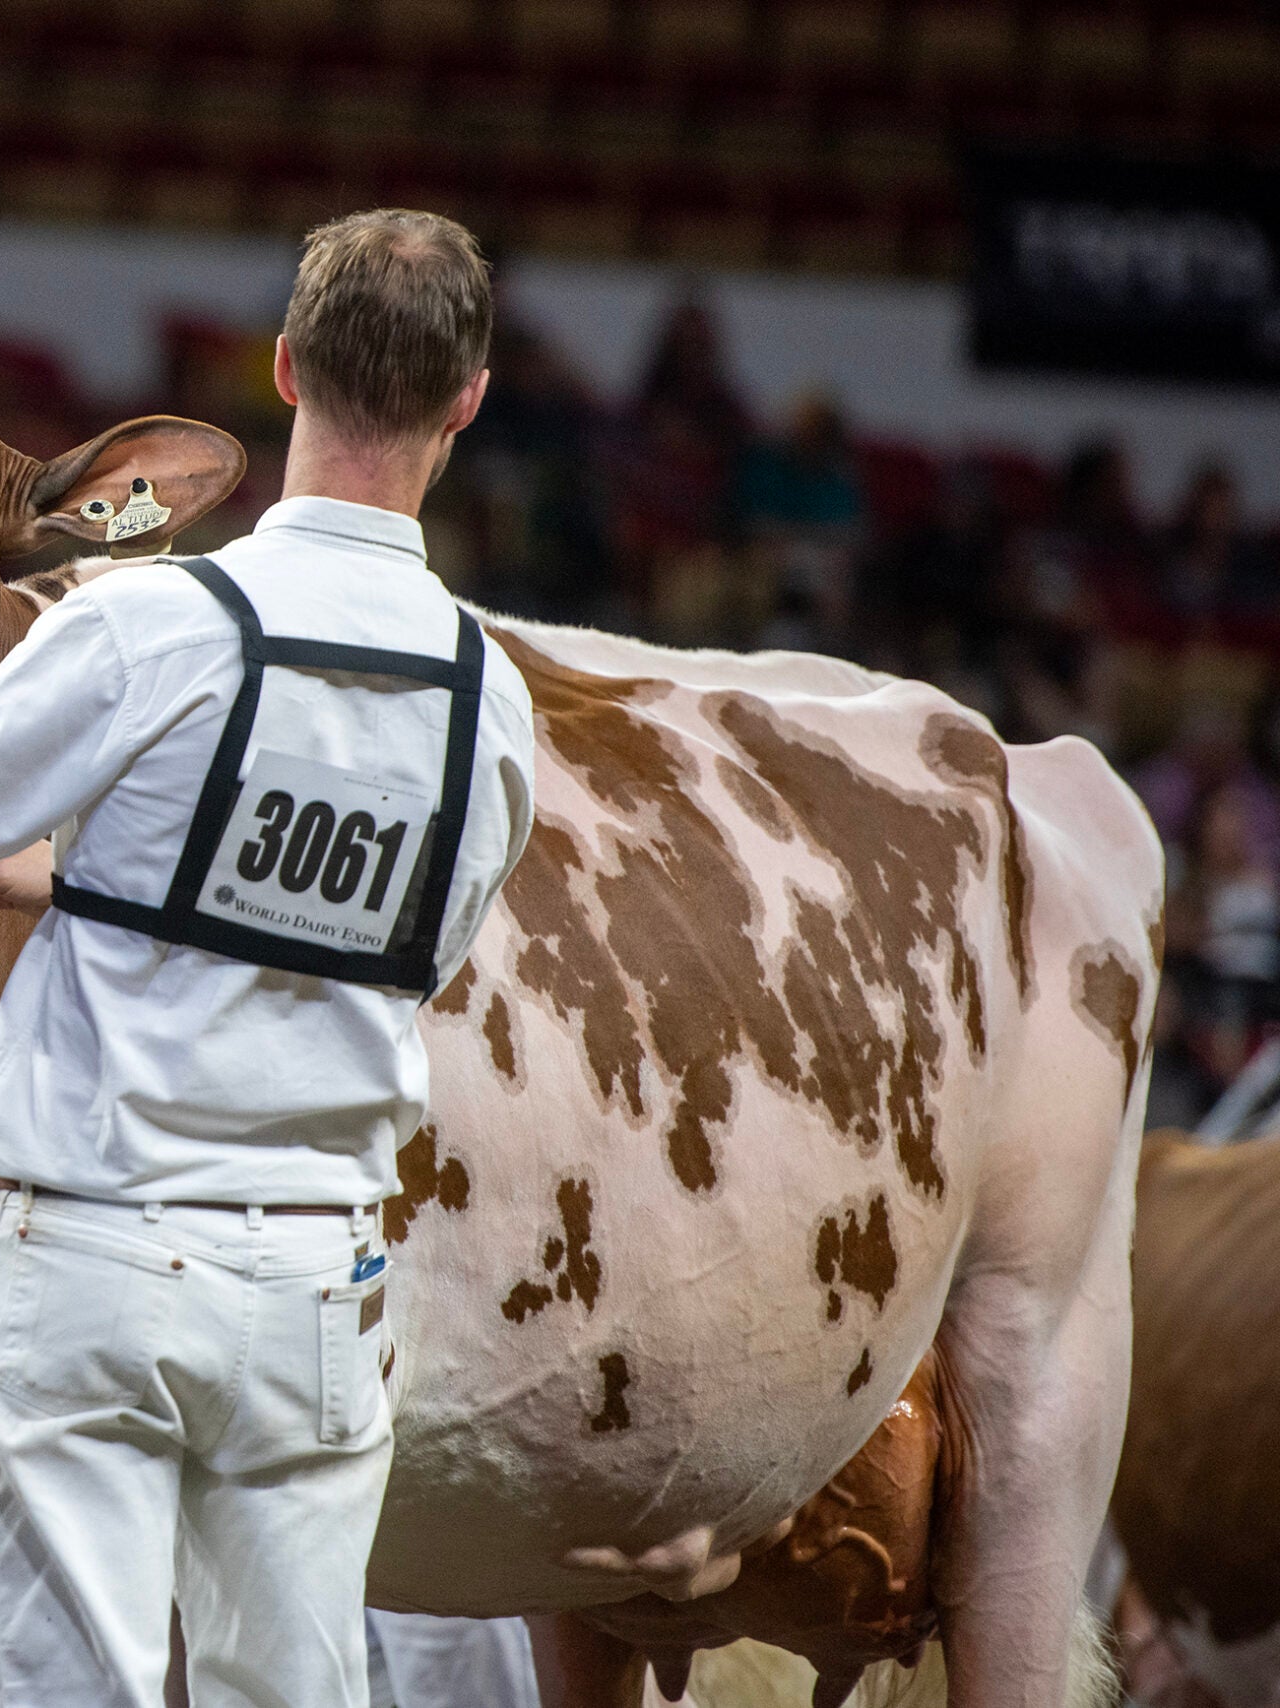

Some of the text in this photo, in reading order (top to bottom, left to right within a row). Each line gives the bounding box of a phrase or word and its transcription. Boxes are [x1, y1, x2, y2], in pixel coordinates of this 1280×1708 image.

[114, 518, 161, 539] 2535
[236, 789, 409, 913] 3061
[233, 899, 382, 947] WORLD DAIRY EXPO
